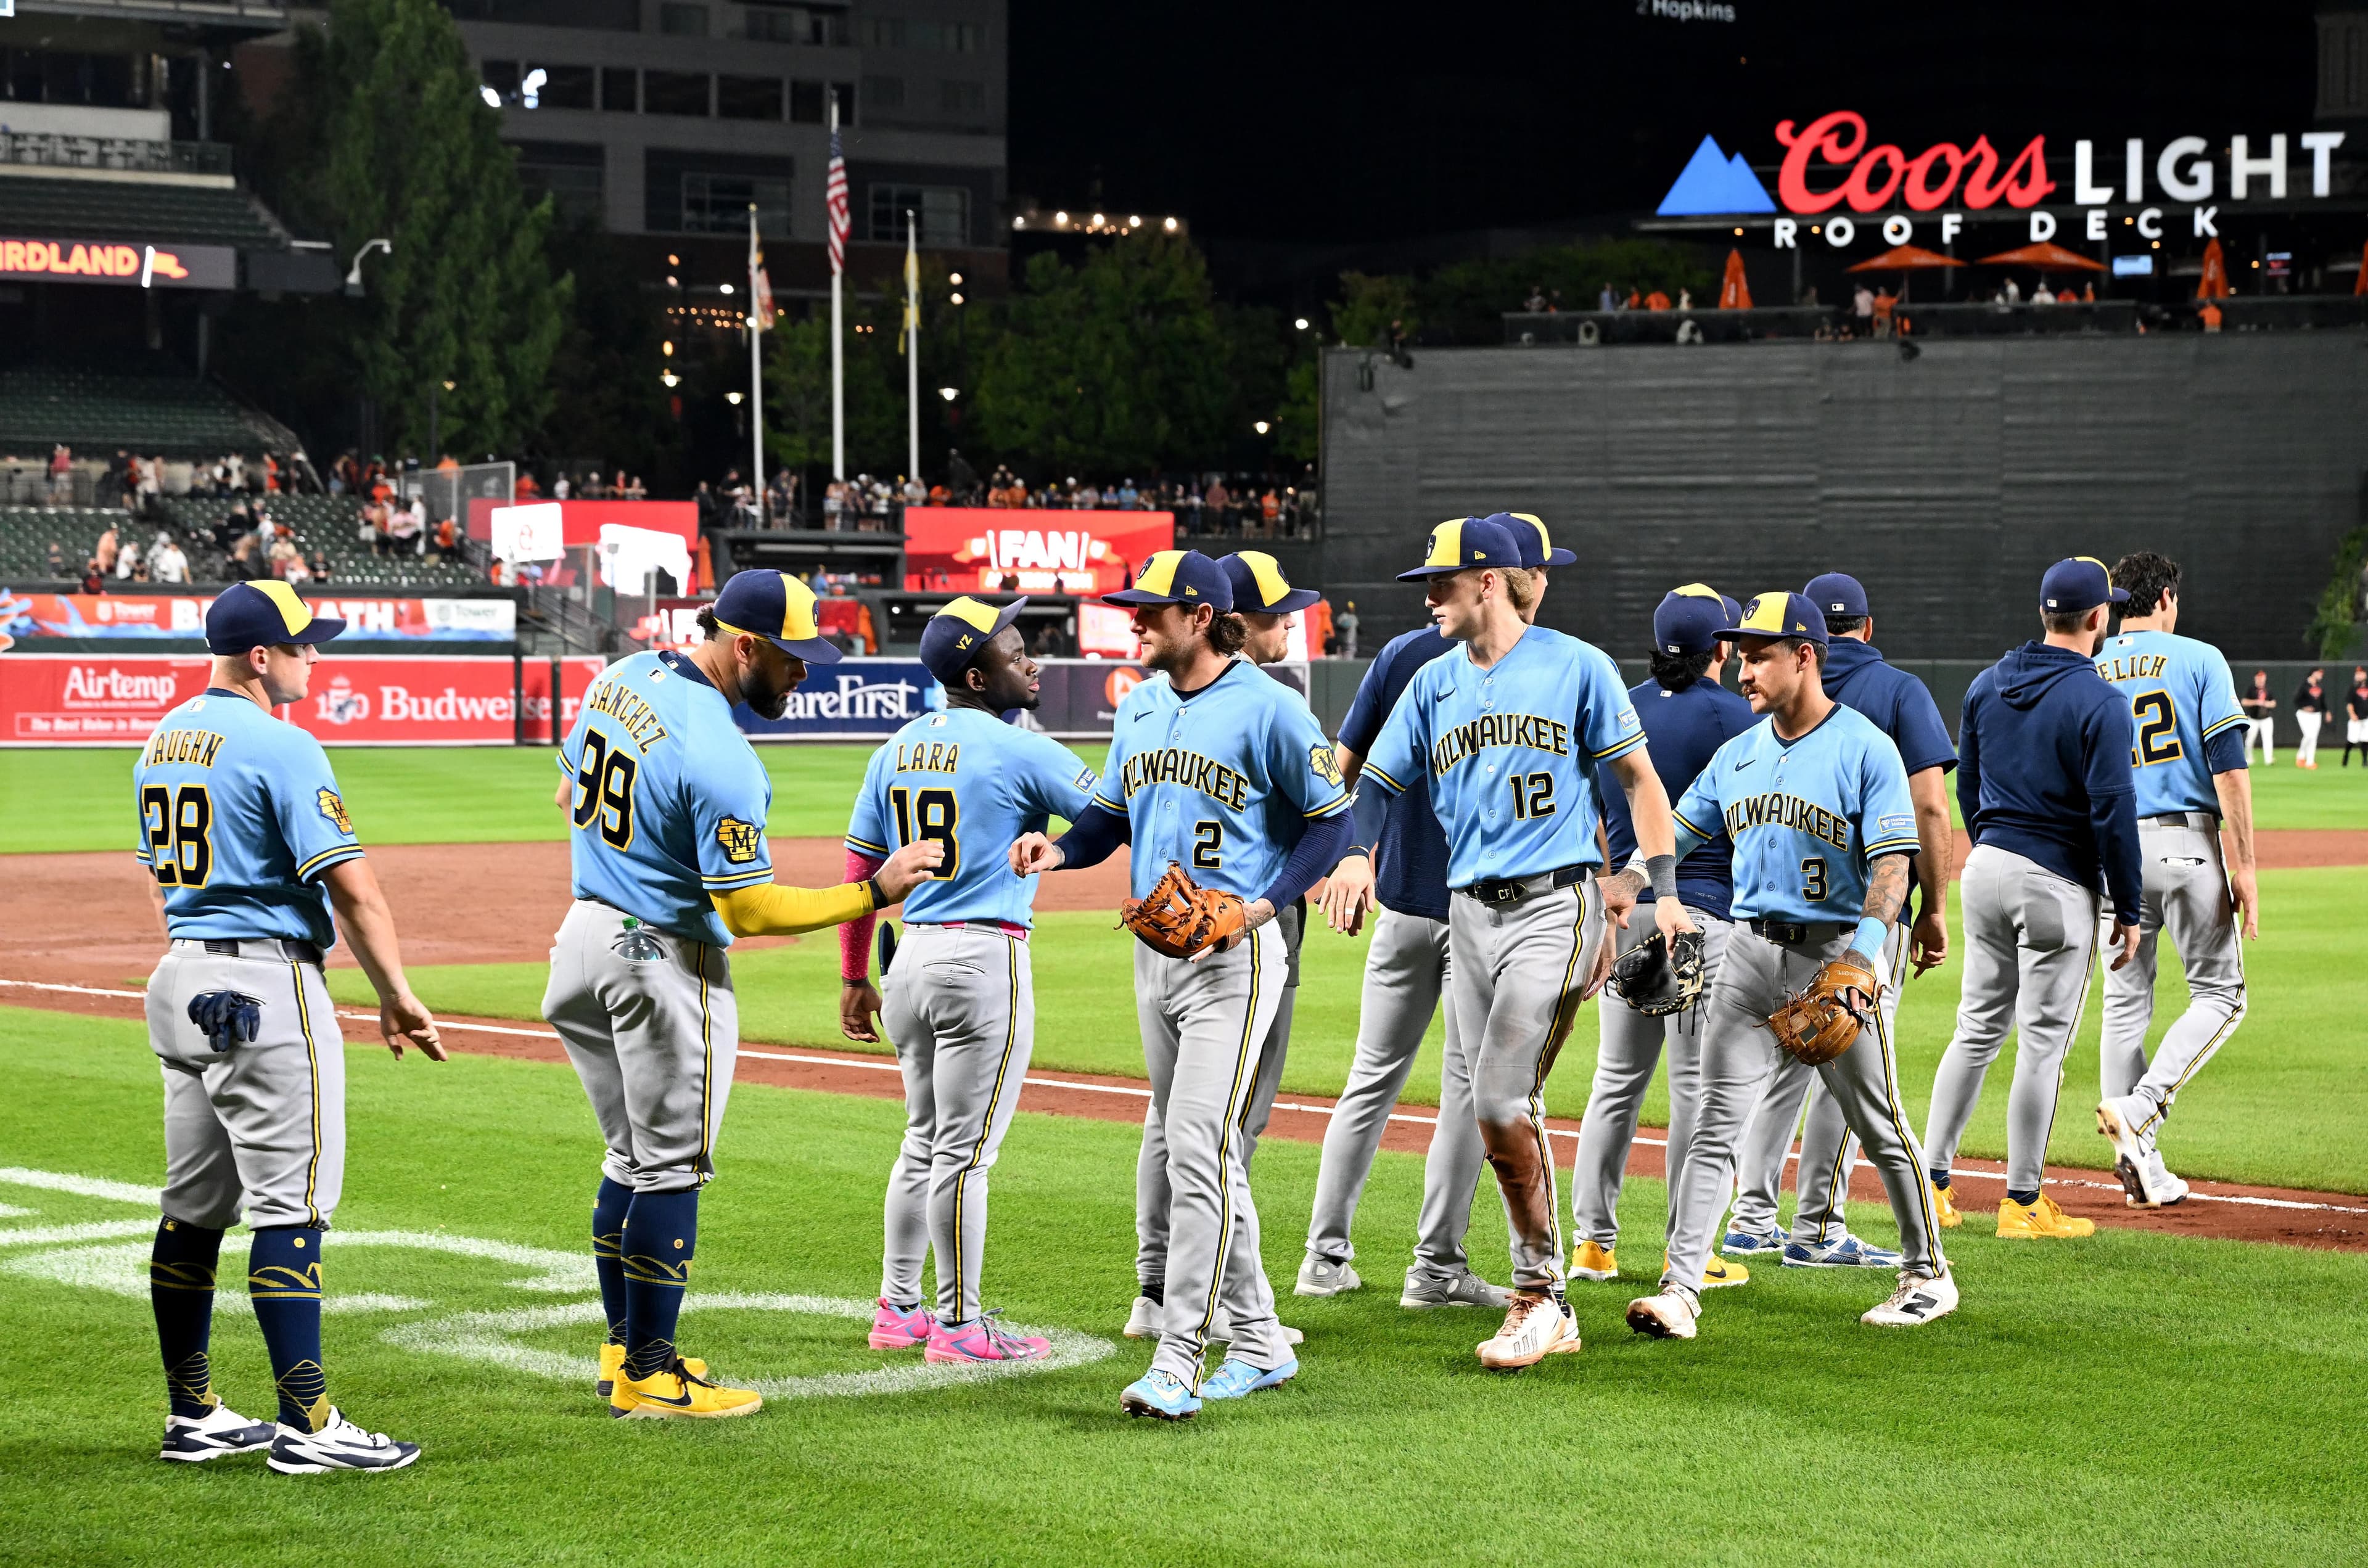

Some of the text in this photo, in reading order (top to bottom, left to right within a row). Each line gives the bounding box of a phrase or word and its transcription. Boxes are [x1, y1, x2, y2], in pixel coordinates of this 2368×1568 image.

[1652, 0, 1736, 22] Hopkins
[1775, 111, 2346, 215] Coors LIGHT
[1774, 207, 2219, 248] ROOF DECK
[1000, 530, 1079, 568] FAN
[303, 601, 395, 632] ATH
[955, 634, 974, 651] VZ
[64, 666, 176, 706] Airtemp
[2097, 654, 2168, 684] ELICH
[782, 675, 919, 720] areFirst
[1432, 713, 1569, 777] MILWAUKEE
[2131, 688, 2184, 768] 2
[896, 742, 960, 774] LARA
[573, 724, 638, 853] 99
[1509, 771, 1557, 821] 12
[141, 783, 214, 890] 28
[890, 786, 960, 882] 18
[1193, 820, 1223, 869] 2
[1800, 857, 1829, 902] 3
[1789, 928, 1795, 940] 3
